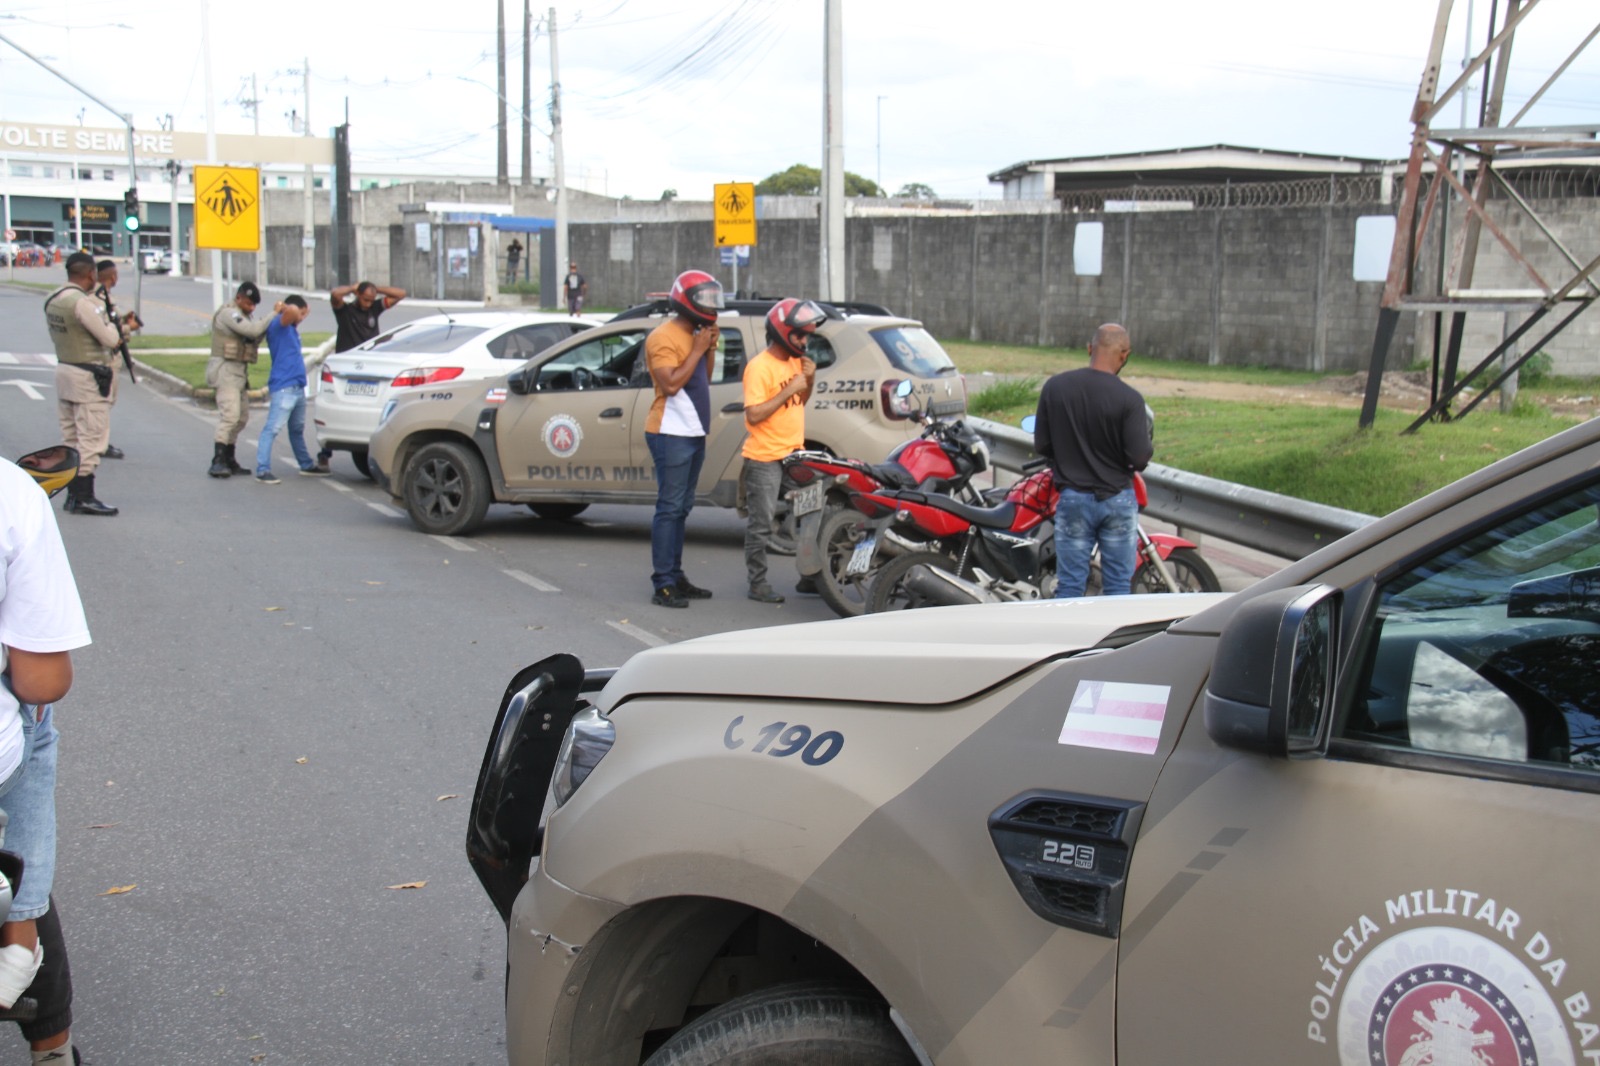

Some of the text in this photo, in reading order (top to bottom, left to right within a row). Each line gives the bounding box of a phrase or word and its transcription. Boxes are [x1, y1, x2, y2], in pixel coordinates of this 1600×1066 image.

[816, 379, 875, 394] 9.2211
[527, 462, 657, 481] POLÍCIA MILI
[751, 721, 844, 766] 190
[1307, 915, 1380, 1044] POLÍCIA
[1384, 889, 1521, 940] MILITAR
[1524, 931, 1567, 987] DA
